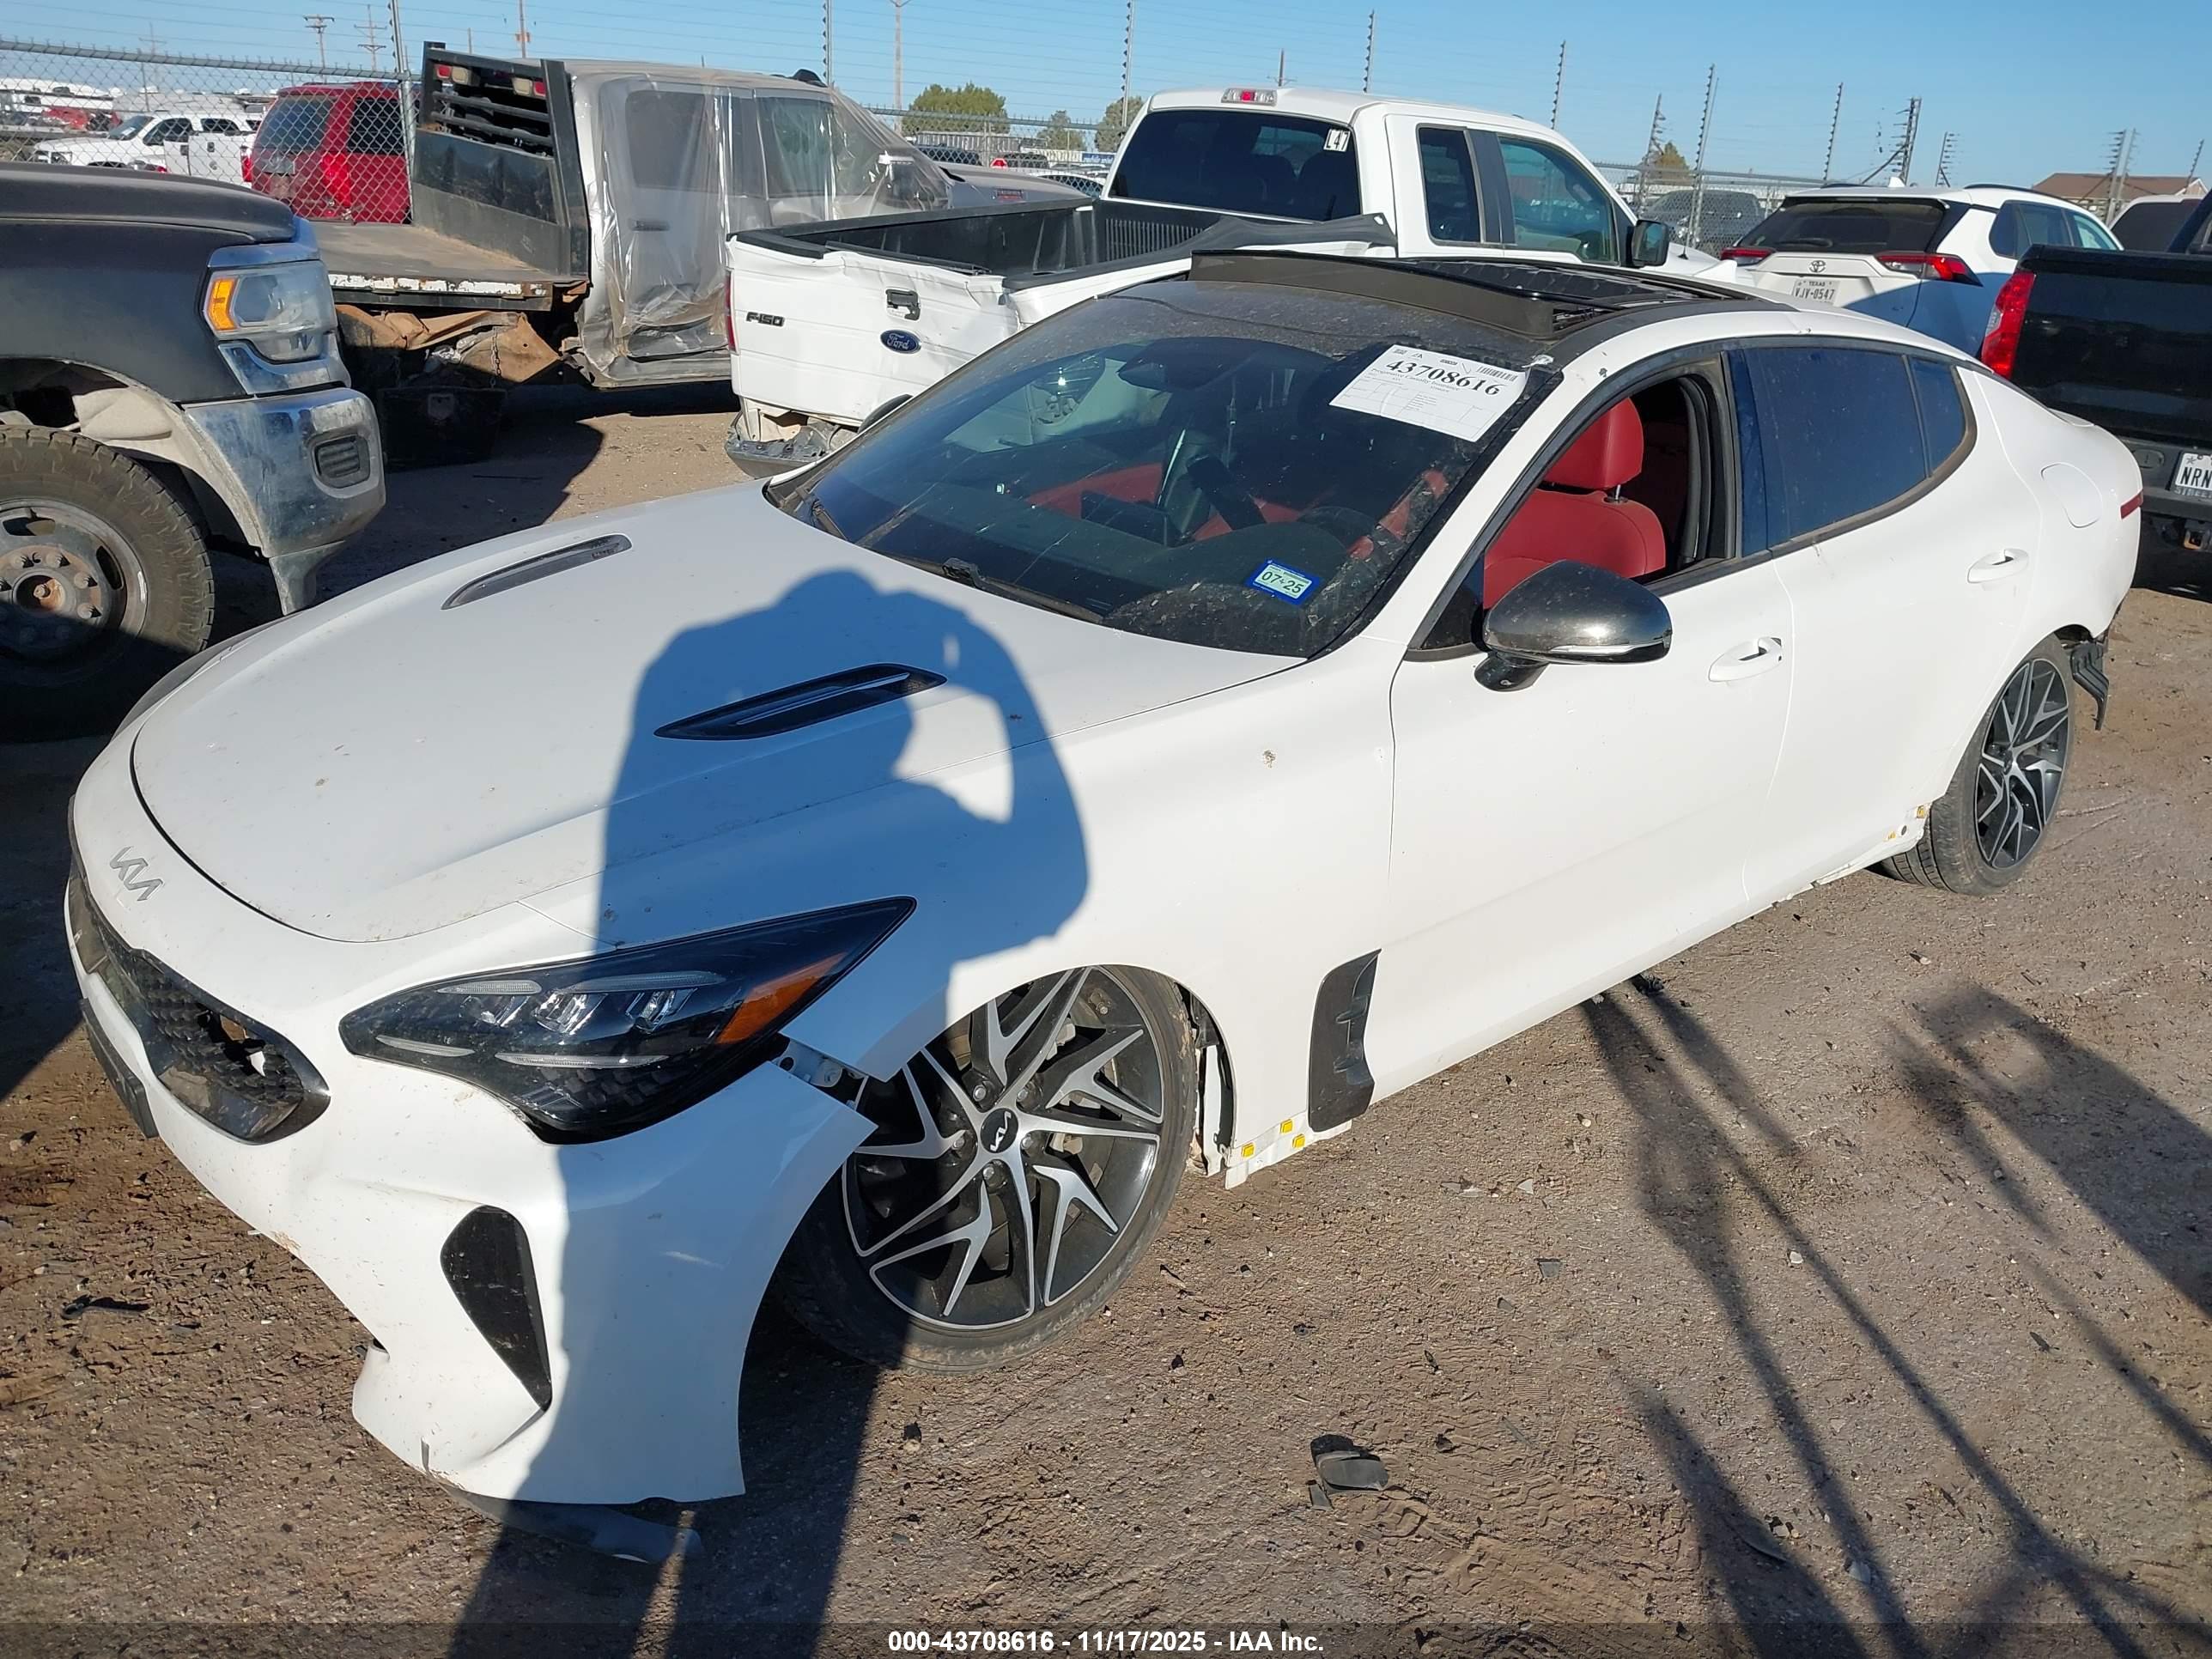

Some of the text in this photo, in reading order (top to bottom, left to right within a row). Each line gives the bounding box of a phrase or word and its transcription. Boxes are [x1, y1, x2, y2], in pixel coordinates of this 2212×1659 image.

[1326, 130, 1348, 150] L47
[745, 312, 785, 326] F-150
[1385, 360, 1506, 395] 43708616
